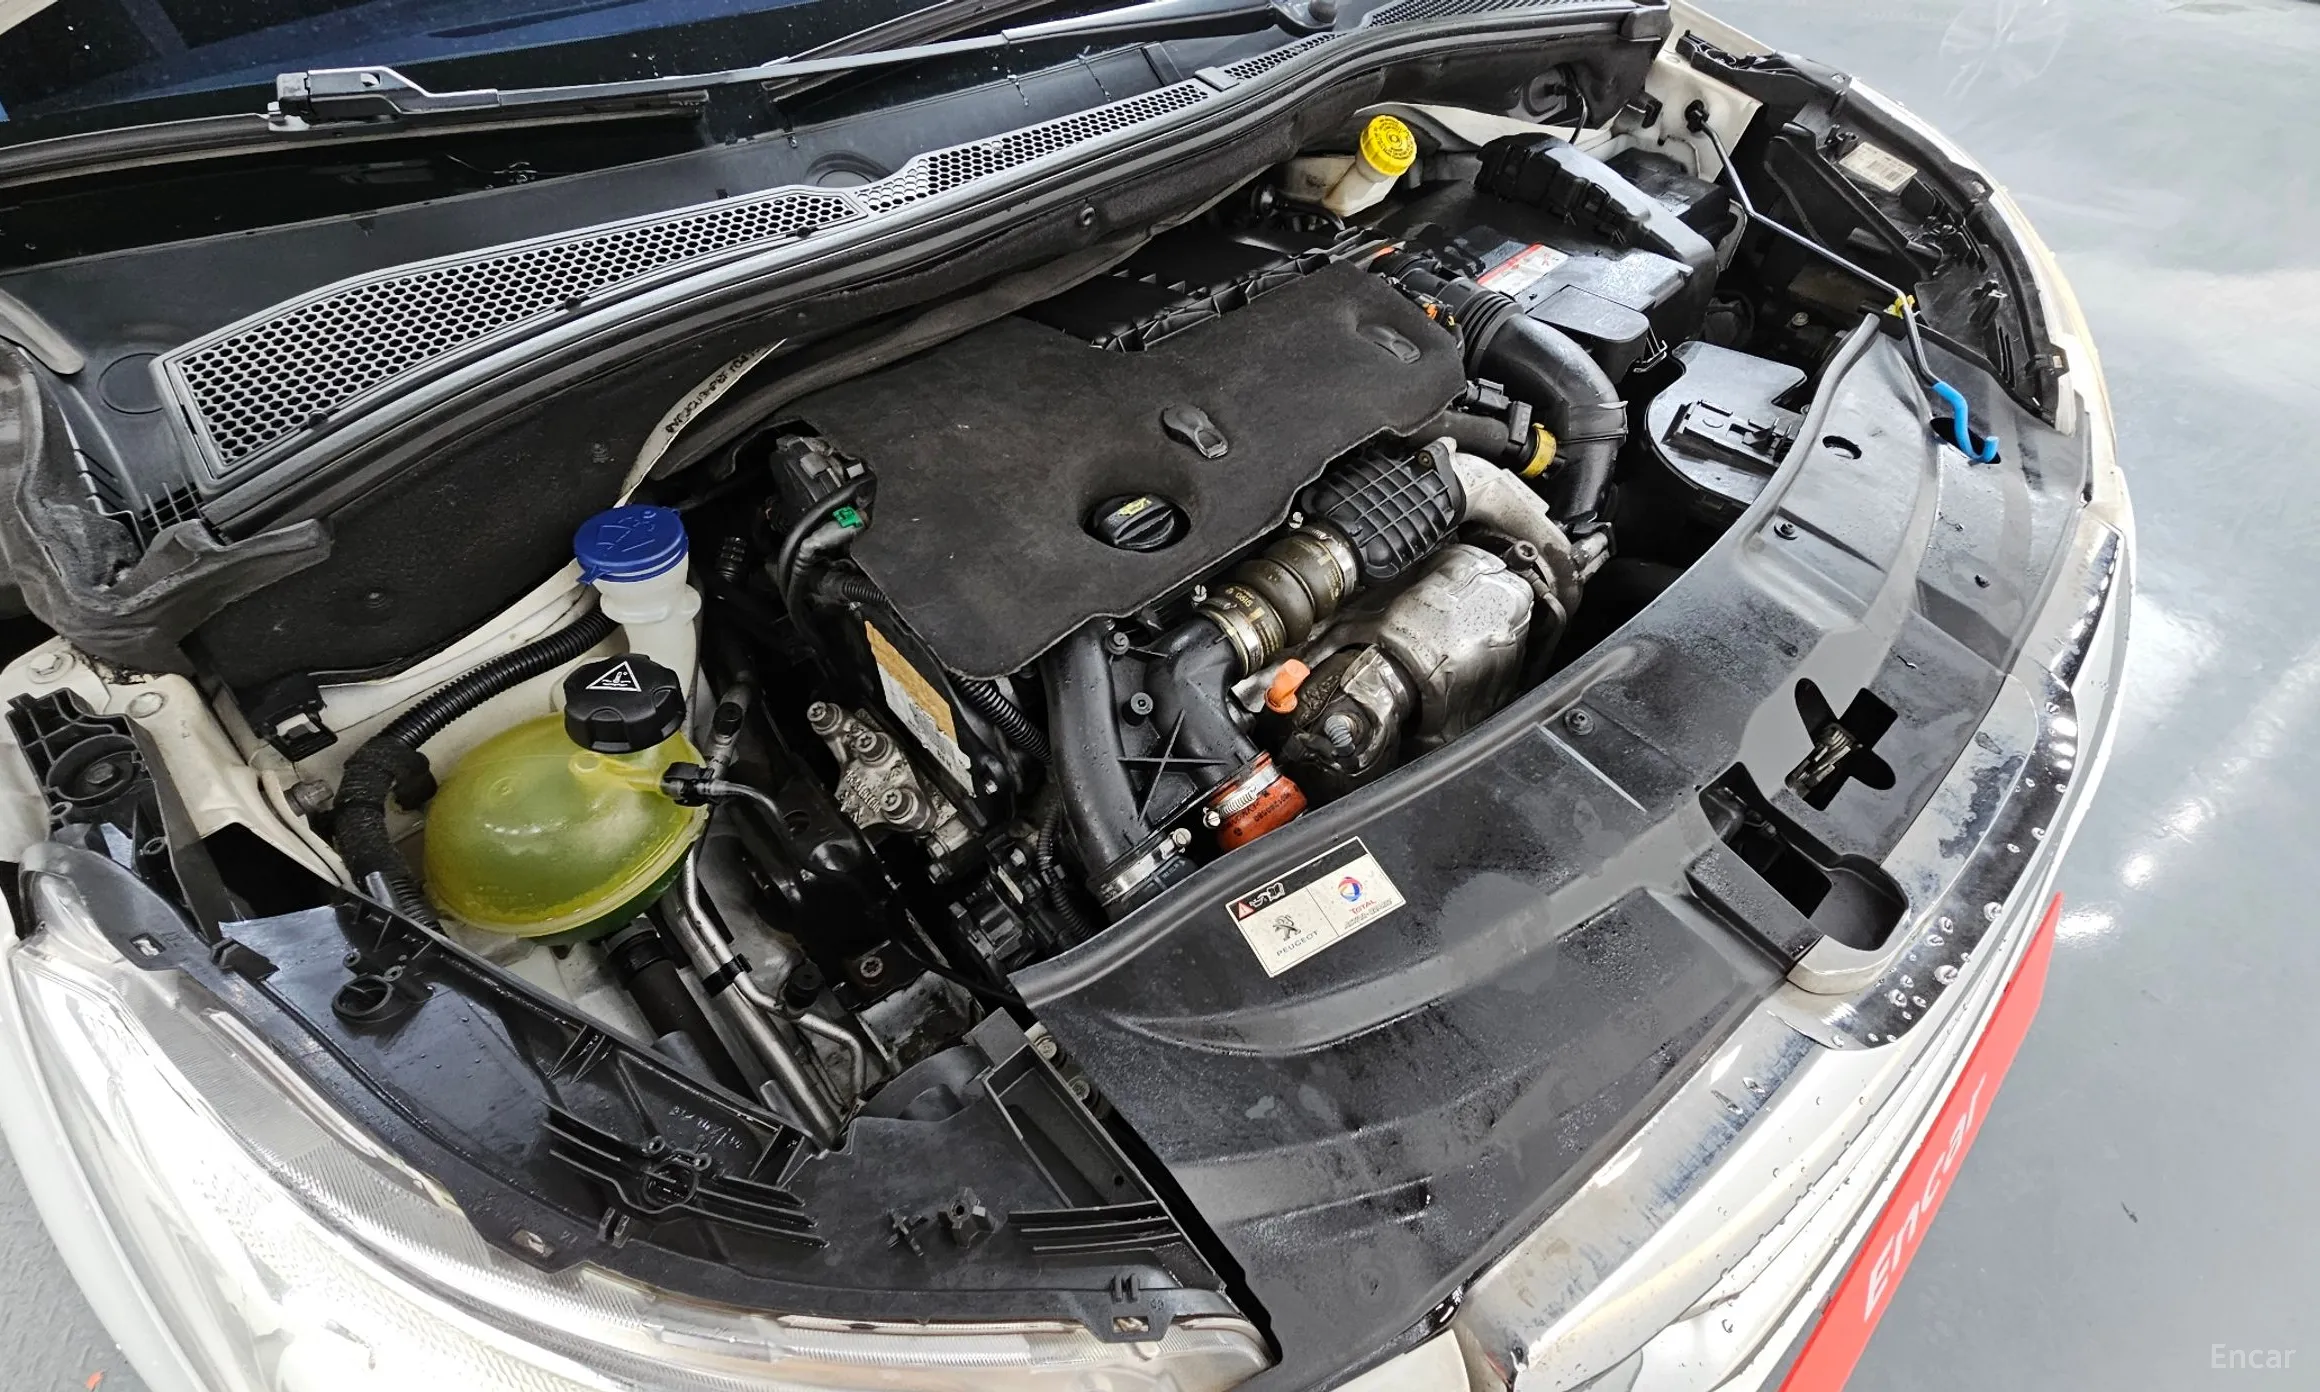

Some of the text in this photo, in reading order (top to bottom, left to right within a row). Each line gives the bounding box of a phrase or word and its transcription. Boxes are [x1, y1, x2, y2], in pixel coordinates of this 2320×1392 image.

[1349, 899, 1377, 915] TOTAL
[1276, 930, 1319, 957] PEUGEOT
[1863, 1072, 1987, 1323] Encar
